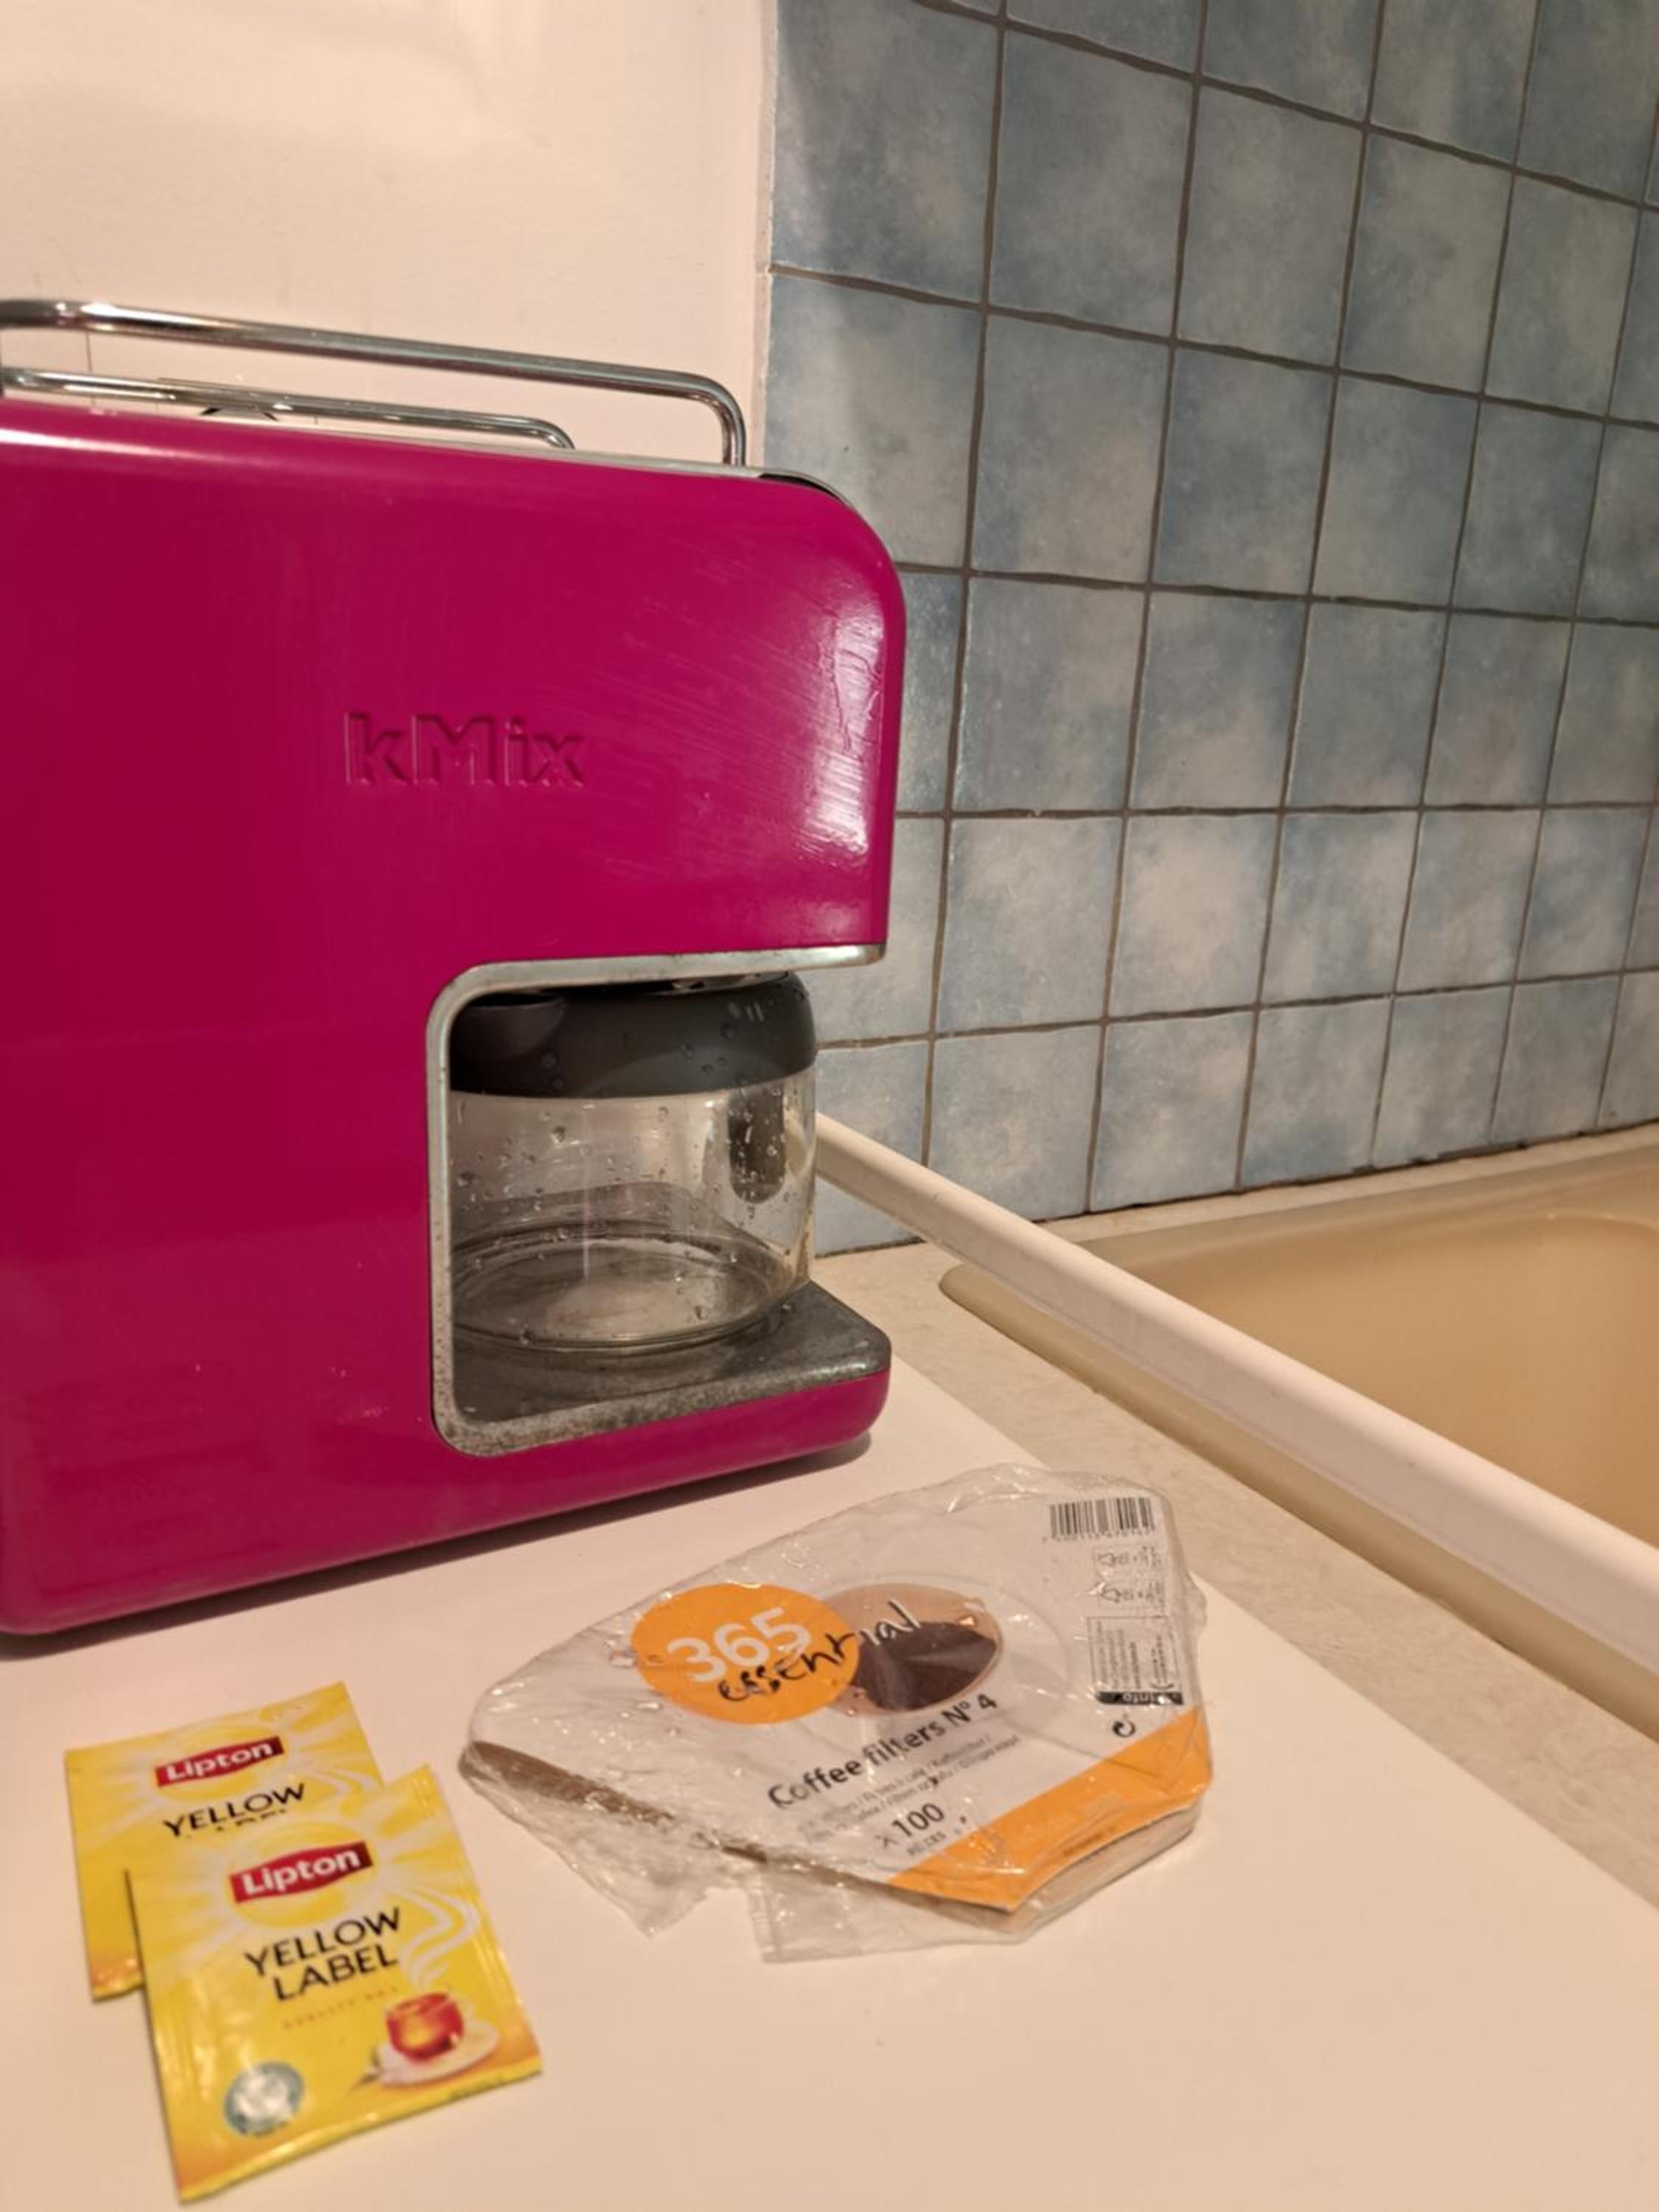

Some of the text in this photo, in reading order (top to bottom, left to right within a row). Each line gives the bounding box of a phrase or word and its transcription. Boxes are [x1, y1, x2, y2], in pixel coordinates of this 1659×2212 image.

[343, 710, 585, 787] kMix
[666, 1606, 812, 1683] 365
[165, 1742, 274, 1781] Lipton
[768, 1767, 863, 1808] Coffee
[861, 1722, 946, 1767] filters
[977, 1694, 998, 1710] 4
[161, 1782, 305, 1837] YELLOW
[891, 1803, 945, 1837] 100
[240, 1850, 361, 1895] Lipton
[244, 1906, 400, 1978] YELLOW
[271, 1943, 400, 2001] LABEL
